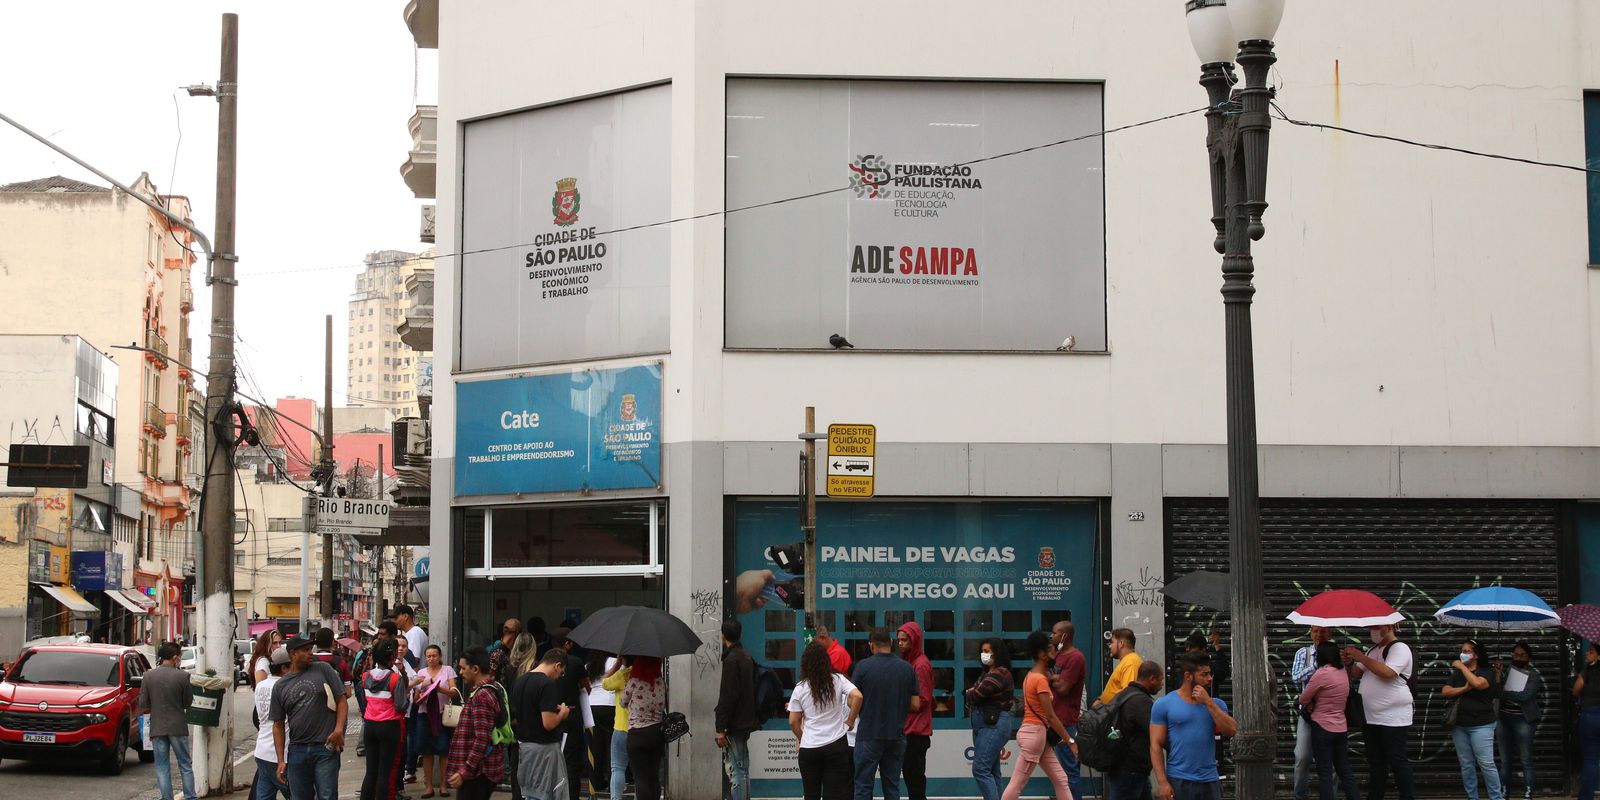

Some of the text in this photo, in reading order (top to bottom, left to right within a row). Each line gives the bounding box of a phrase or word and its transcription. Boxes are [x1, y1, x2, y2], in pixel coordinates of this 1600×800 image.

[894, 164, 972, 178] FUNDAÇÃO
[894, 177, 982, 189] PAULISTANA
[894, 190, 956, 200] DE EDUCAÇÃO,
[895, 200, 947, 209] TECNOLOGIA
[894, 209, 939, 218] E CULTURA
[534, 226, 597, 247] CIDADE DE
[525, 242, 607, 268] SÃO PAULO
[851, 245, 979, 276] ADE SAMPA
[529, 262, 603, 280] DESENVOLVIMENTO
[542, 275, 589, 289] ECONÔMICO
[851, 276, 877, 284] AGÊNCIA
[922, 278, 979, 286] DESENVOLVIMENTO
[542, 286, 589, 299] E TRABALHO
[500, 410, 540, 430] Cate
[609, 422, 647, 433] CIDADE DE
[830, 427, 873, 435] PEDESTRE
[623, 431, 652, 442] PAULO
[832, 436, 871, 445] CUIDADO
[488, 441, 554, 453] CENTRO DE APOIO AO
[835, 444, 867, 453] ÔNIBUS
[468, 454, 501, 463] TRABALHO
[507, 450, 575, 461] EMPREENDEDORISMO
[318, 499, 388, 516] Rio Branco
[821, 546, 1016, 563] PAINEL DE VAGAS
[1022, 576, 1071, 585] SÃO PAULO
[821, 582, 1015, 599] DE EMPREGO AQUI
